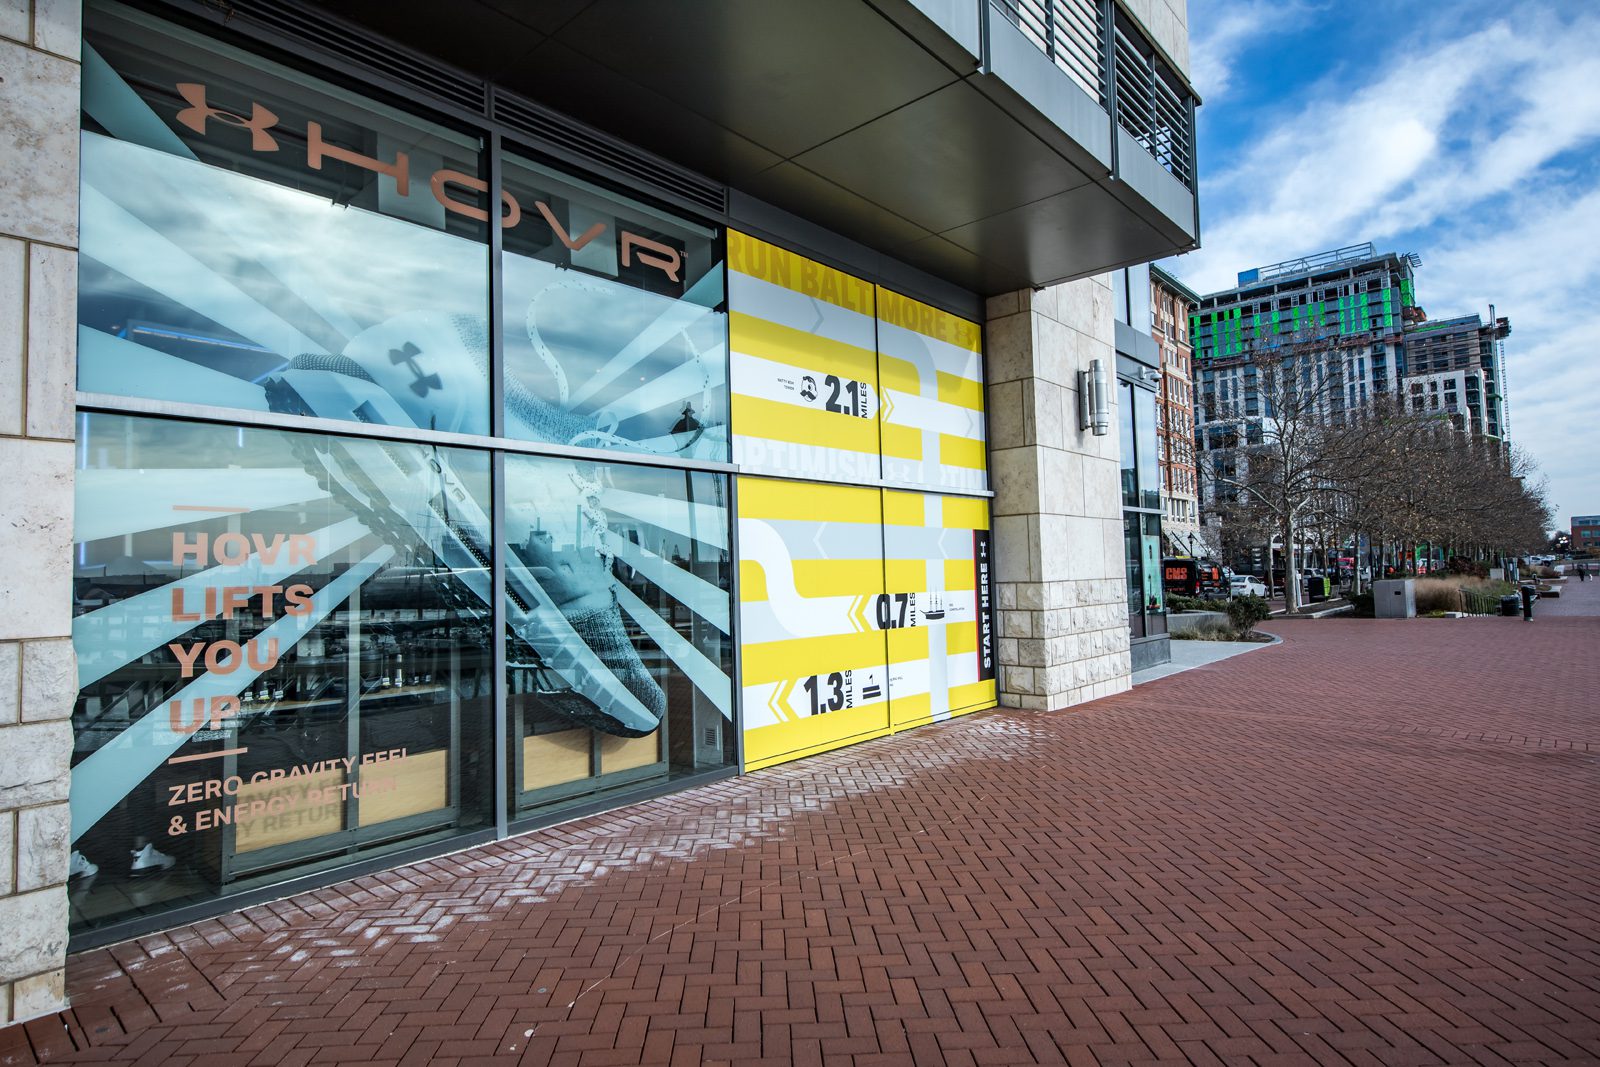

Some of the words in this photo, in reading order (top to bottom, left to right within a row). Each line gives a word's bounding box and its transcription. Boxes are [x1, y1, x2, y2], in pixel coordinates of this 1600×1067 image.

[307, 120, 681, 283] HOVR
[727, 233, 791, 290] RUN
[824, 374, 859, 417] 2.1
[859, 382, 868, 419] MILES
[171, 531, 318, 567] HOVR
[171, 583, 315, 623] LIFTS
[980, 562, 990, 608] HERE
[876, 592, 908, 630] 0.7
[909, 592, 917, 627] MILES
[168, 637, 280, 678] YOU
[982, 611, 992, 669] START
[803, 671, 844, 716] 1.3
[844, 669, 853, 709] MILES
[169, 694, 241, 734] UP
[168, 775, 244, 807] ZERO
[250, 755, 357, 787] GRAVITY
[167, 815, 188, 836] &
[195, 794, 299, 832] ENERGY
